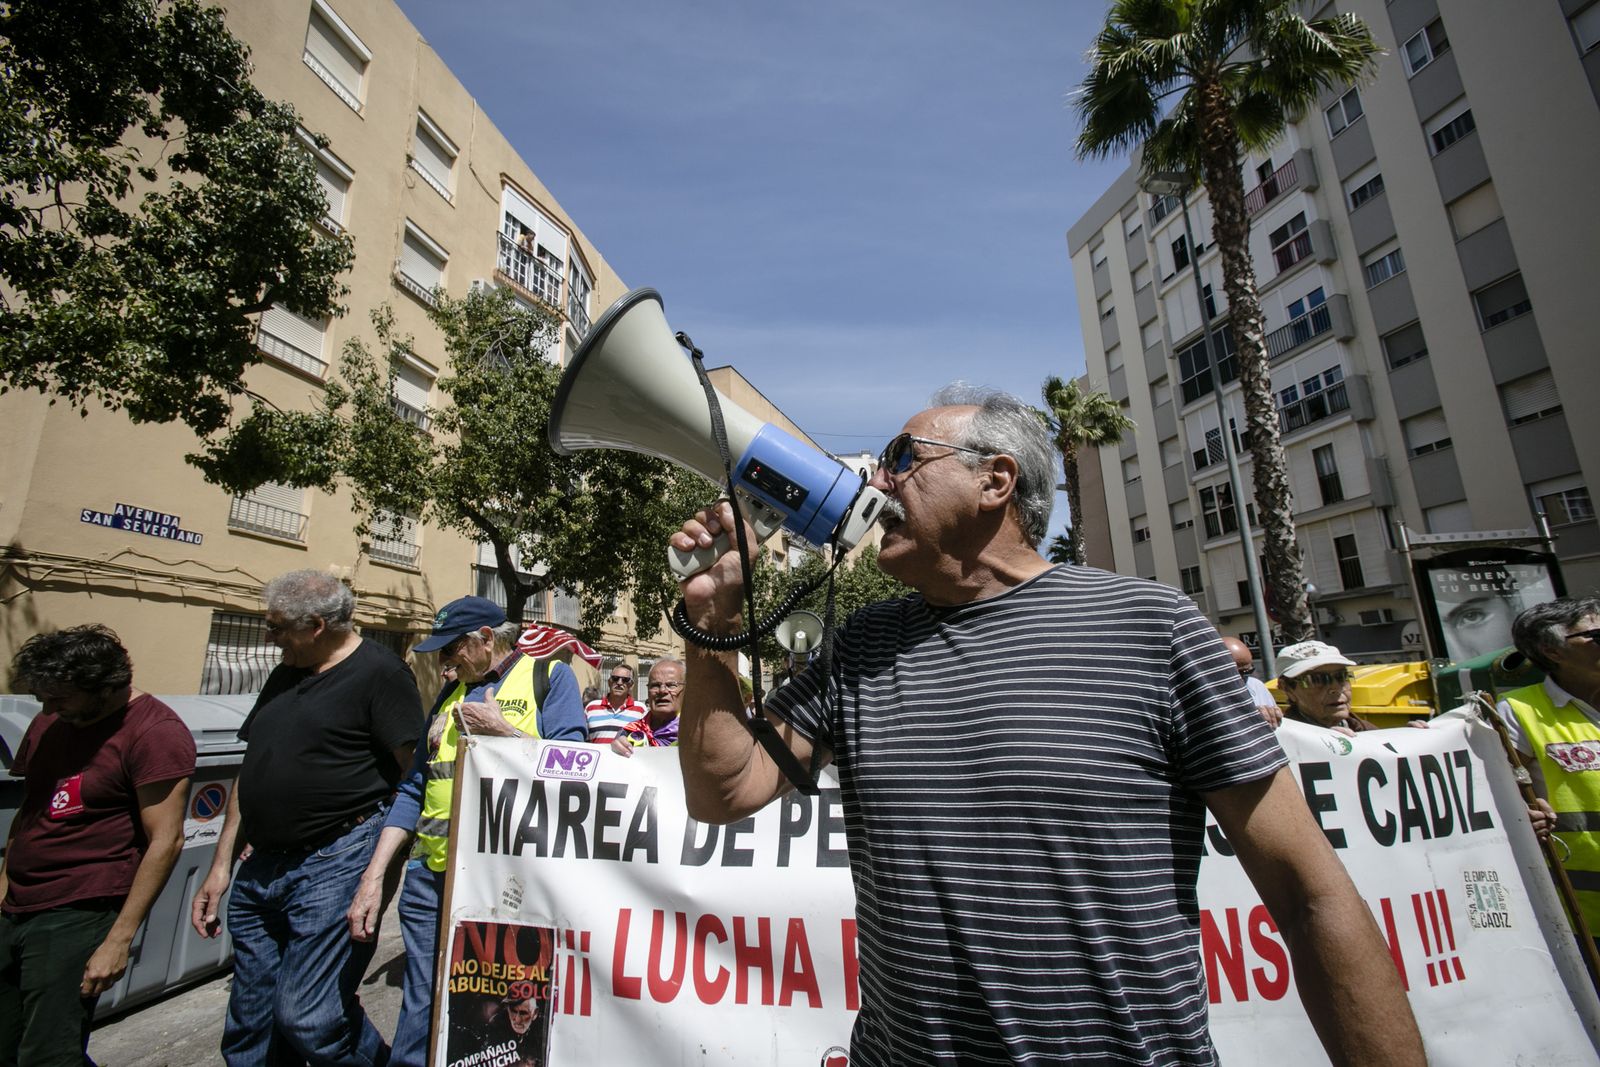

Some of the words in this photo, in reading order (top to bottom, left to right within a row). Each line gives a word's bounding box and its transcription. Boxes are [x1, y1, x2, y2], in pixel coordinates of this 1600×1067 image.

[82, 510, 113, 526] SAN
[123, 518, 202, 544] SEVERIANO
[115, 505, 179, 527] AVENIDA
[1440, 584, 1460, 593] TU
[542, 768, 588, 778] PRECARIEDAD
[477, 777, 659, 864] MAREA
[1472, 870, 1499, 882] EMPLEO
[612, 908, 823, 1008] LUCHA
[452, 958, 479, 977] NO
[481, 961, 527, 981] DEJES
[529, 965, 550, 982] AL
[448, 976, 509, 997] ABUELO
